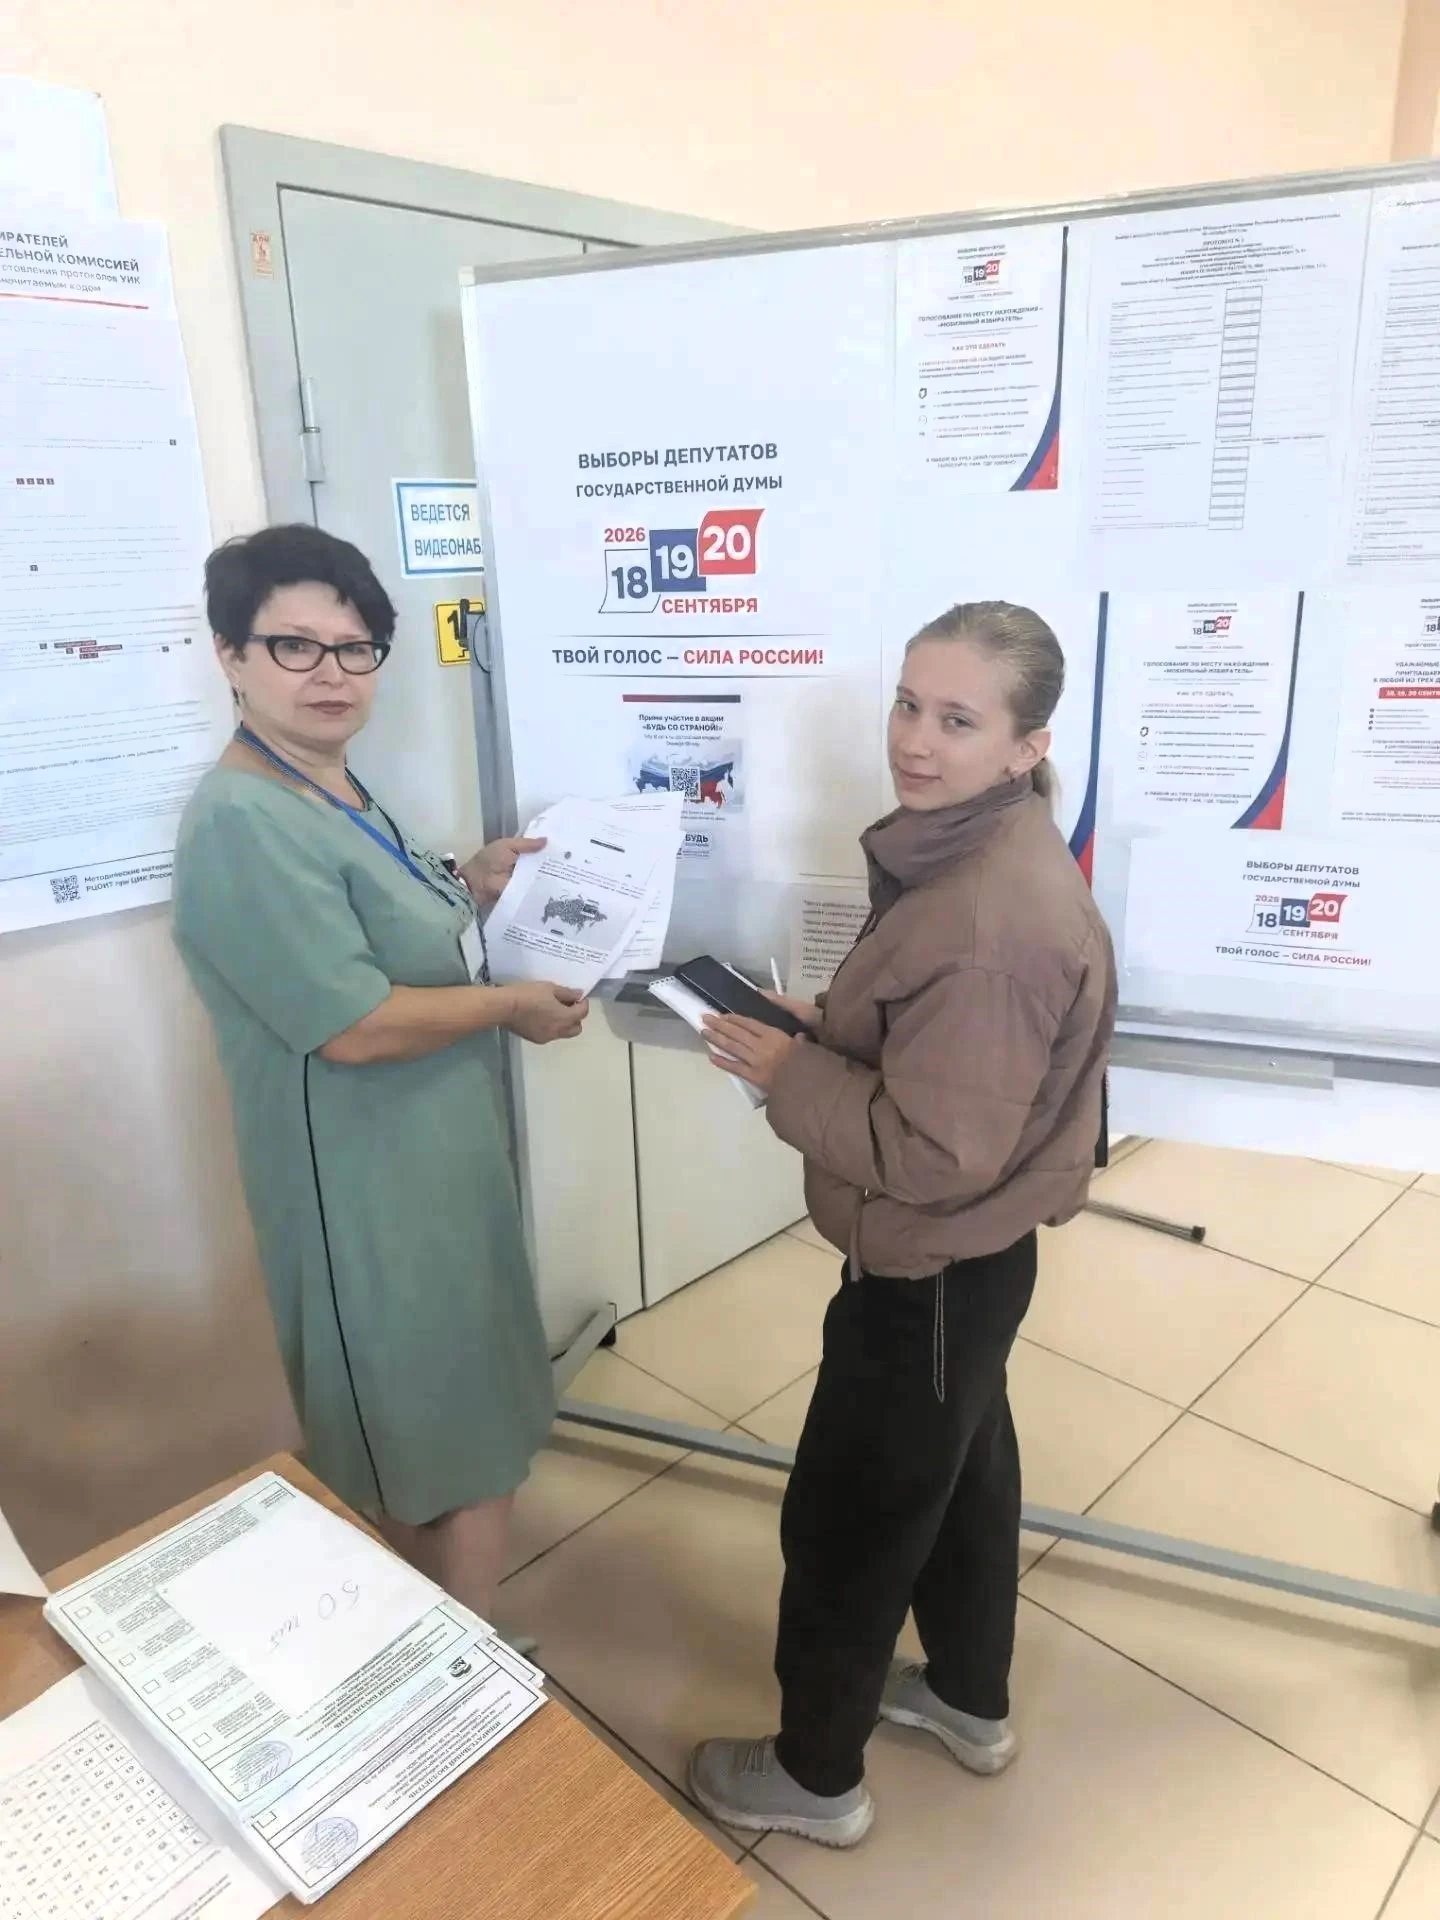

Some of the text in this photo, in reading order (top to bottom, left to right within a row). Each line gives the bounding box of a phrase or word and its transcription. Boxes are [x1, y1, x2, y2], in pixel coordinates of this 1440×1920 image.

[57, 253, 139, 272] КОМИССИЕЙ
[120, 275, 140, 284] УИК
[578, 443, 778, 469] ВЫБОРЫ ДЕПУТАТОВ
[576, 475, 782, 498] ГОСУДАРСТВЕННОЙ ДУМЫ
[411, 504, 470, 524] ВЕДЕТСЯ
[604, 527, 646, 542] 2026
[702, 524, 751, 560] 20
[415, 538, 481, 558] ВИДЕОНАБ
[655, 544, 694, 580] 19
[611, 566, 649, 599] 18
[661, 598, 758, 614] СЕНТЯБРЯ
[1426, 624, 1436, 632] 18
[552, 646, 599, 664] ТВОЙ
[604, 650, 662, 664] ГОЛОС
[684, 650, 733, 664] СИЛА
[739, 649, 823, 664] РОССИИ!
[686, 834, 708, 843] БУДЬ
[1246, 861, 1359, 875] ВЫБОРЫ ДЕПУТАТОВ
[1243, 874, 1360, 888] ГОСУДАРСТВЕННОЙ ДУМЫ
[1283, 905, 1306, 921] 19
[1310, 899, 1339, 917] 20
[1256, 912, 1277, 928] 18
[1283, 929, 1338, 940] СЕНТЯБРЯ
[1216, 946, 1242, 955] ТВОЙ
[1245, 949, 1280, 958] ГОЛОС
[1292, 952, 1320, 961] СИЛА
[1324, 955, 1371, 966] РОССИИ!
